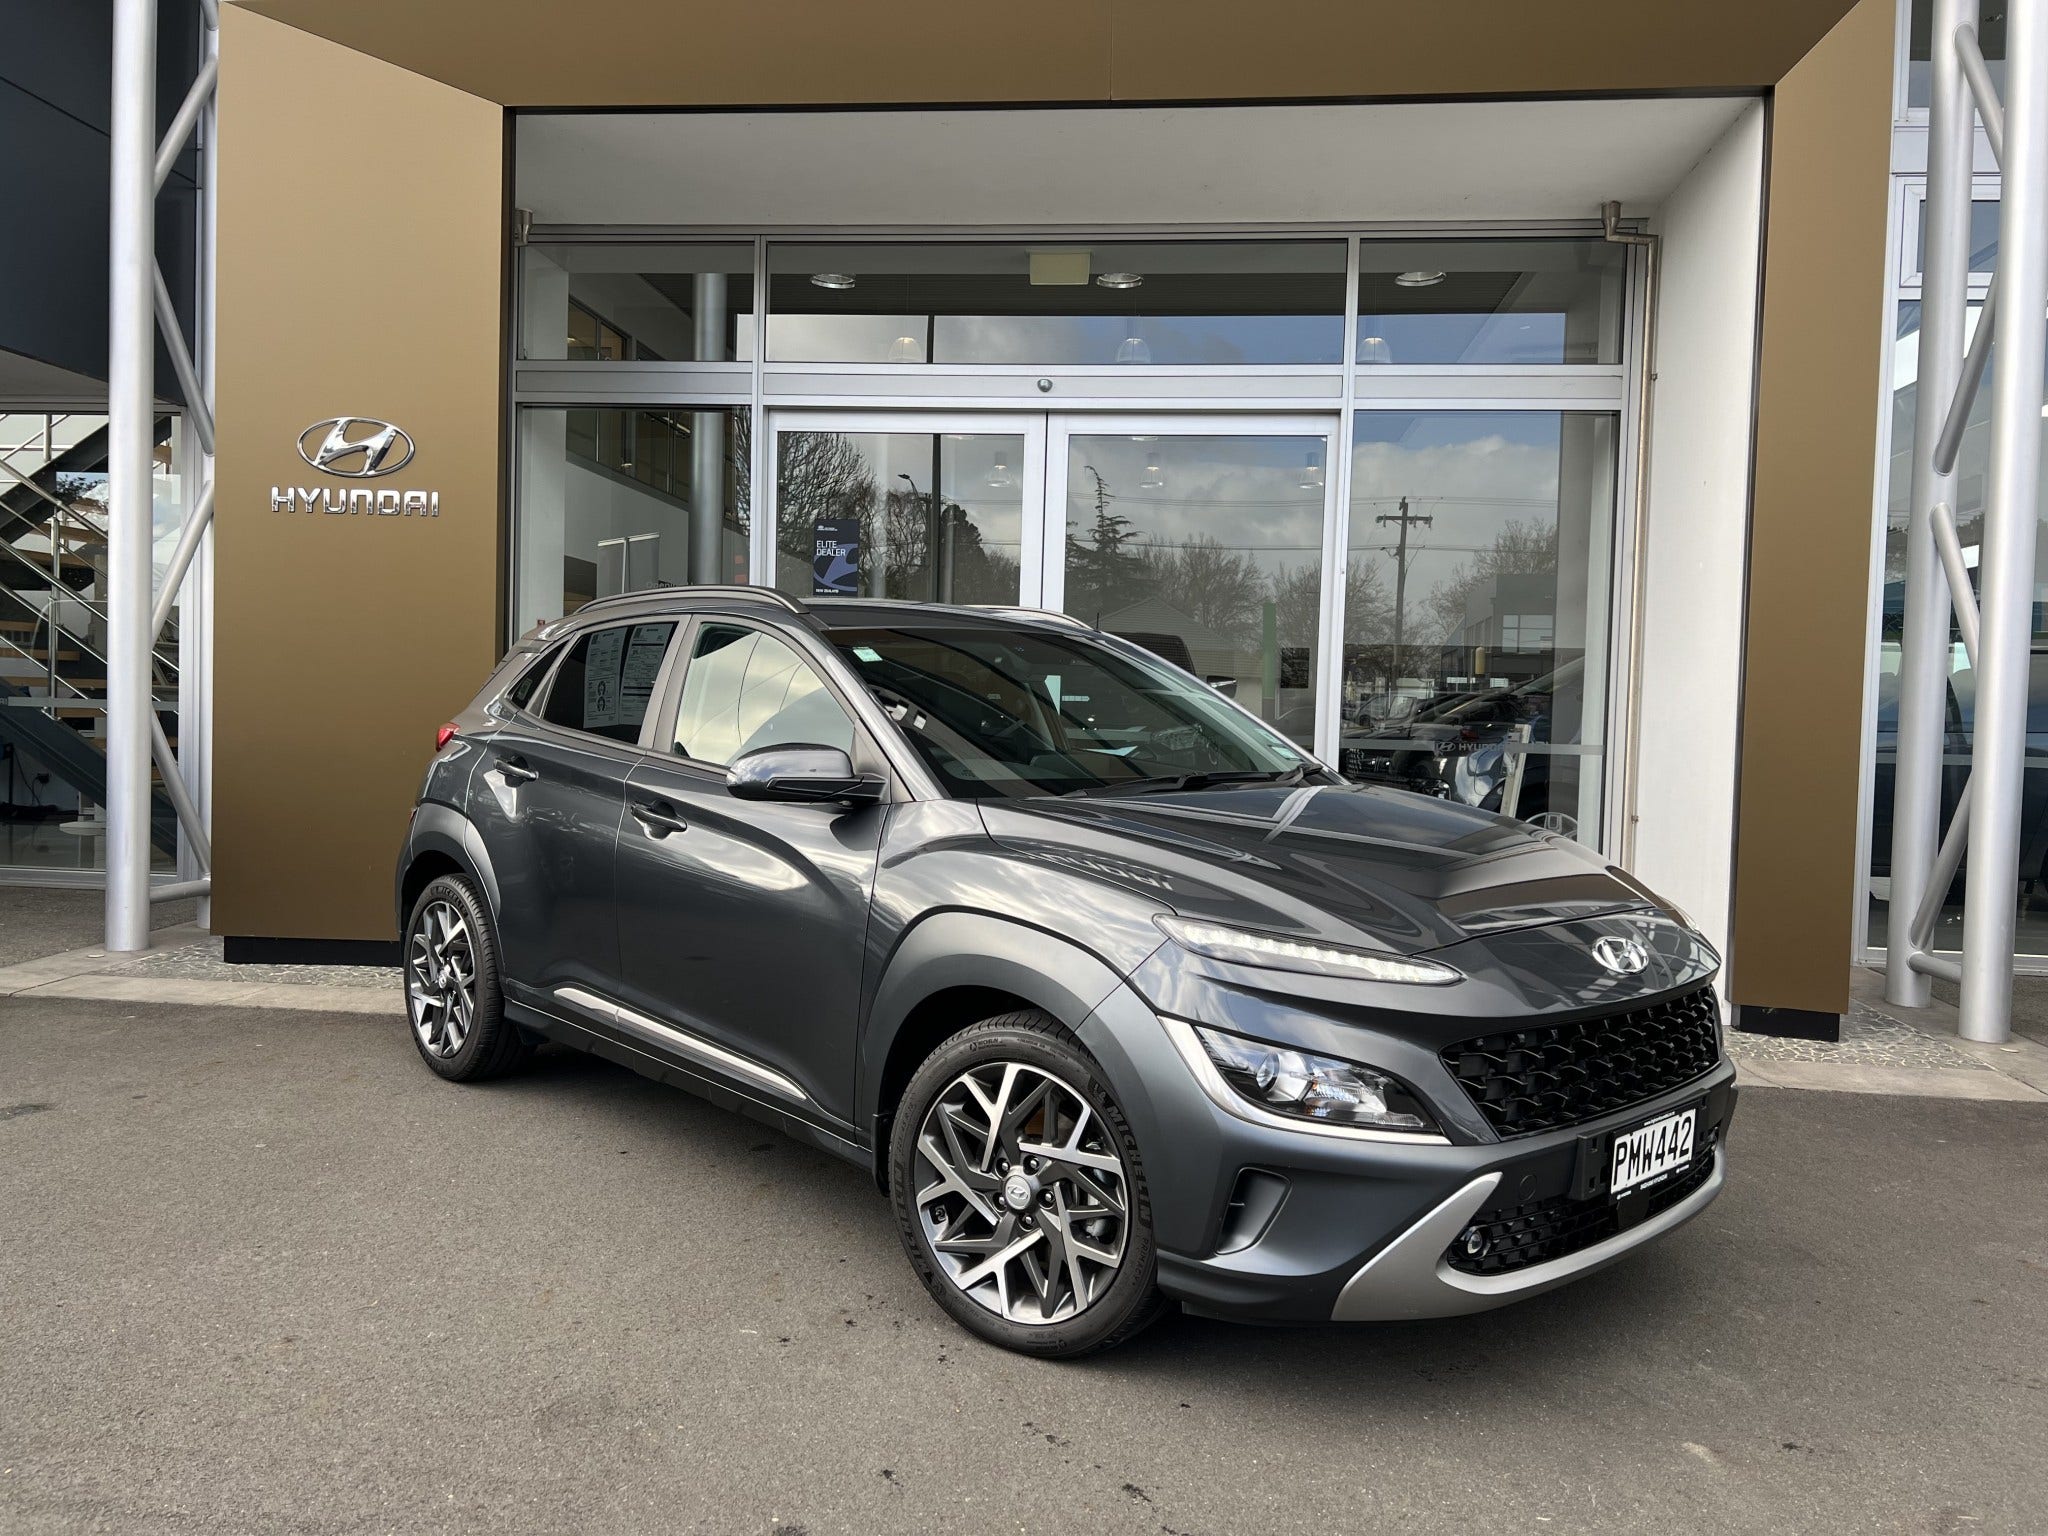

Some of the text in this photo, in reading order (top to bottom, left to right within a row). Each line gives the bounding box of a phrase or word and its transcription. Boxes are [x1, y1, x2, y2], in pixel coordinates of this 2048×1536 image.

[271, 486, 439, 517] HYUNDAI
[816, 540, 837, 549] ELITE
[816, 548, 846, 557] DEALER
[1458, 743, 1506, 752] HYUNDA
[1105, 1104, 1153, 1230] MICHELIN
[1613, 1116, 1692, 1186] PMW442
[894, 1160, 926, 1274] MICHELIN
[1132, 1237, 1150, 1281] PRIMACY
